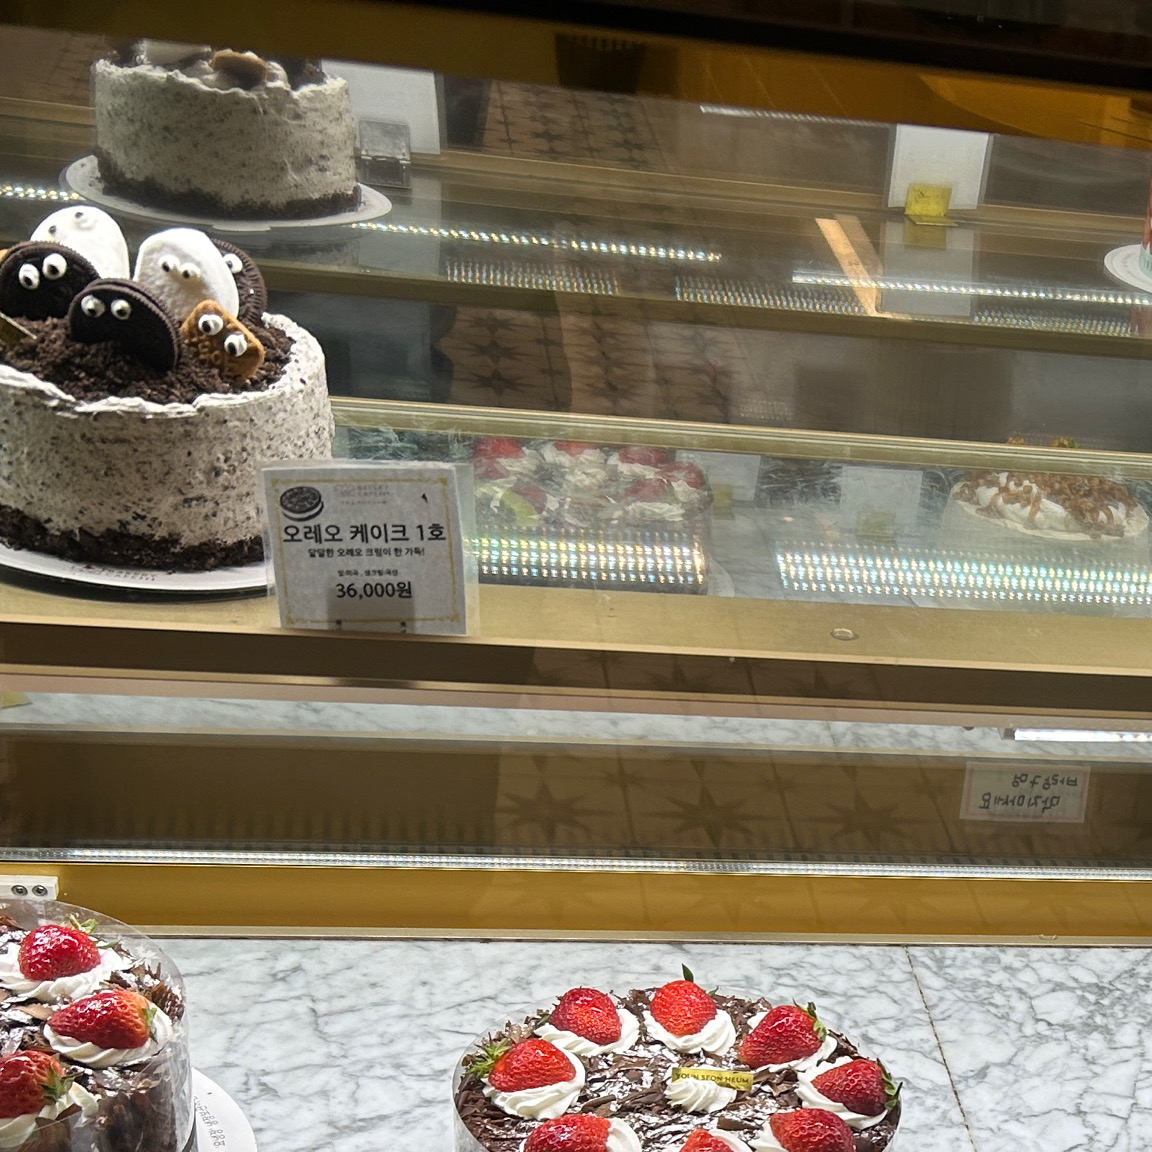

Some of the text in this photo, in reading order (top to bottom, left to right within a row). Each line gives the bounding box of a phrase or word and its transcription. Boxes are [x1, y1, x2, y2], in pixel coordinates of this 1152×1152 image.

[283, 523, 447, 545] 오레오 케이크 1호
[337, 548, 363, 557] 오레오
[365, 548, 391, 557] 크림이
[336, 581, 412, 600] 36,000원
